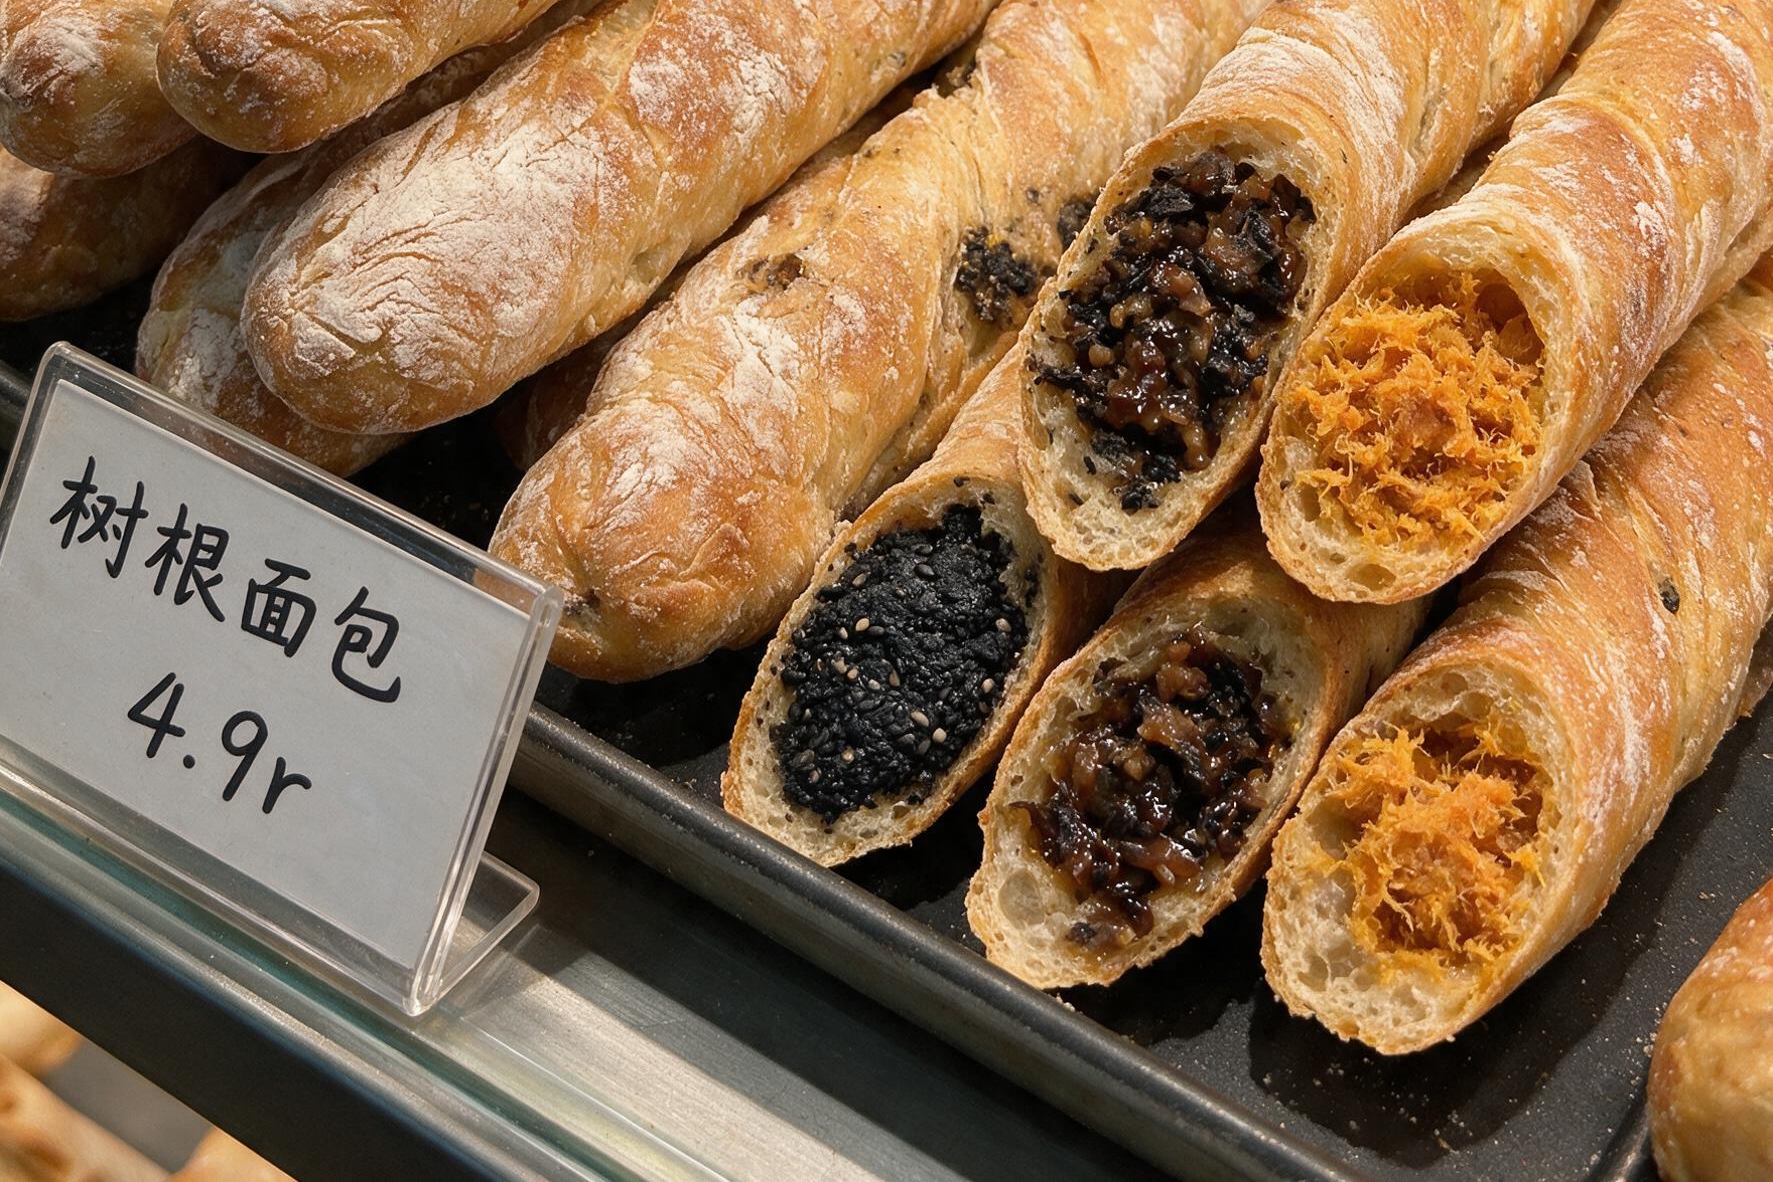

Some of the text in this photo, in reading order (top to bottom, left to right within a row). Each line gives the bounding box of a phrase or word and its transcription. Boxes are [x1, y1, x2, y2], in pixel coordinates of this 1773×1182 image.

[49, 455, 402, 704] 树根面包
[127, 672, 312, 815] 4.9r
